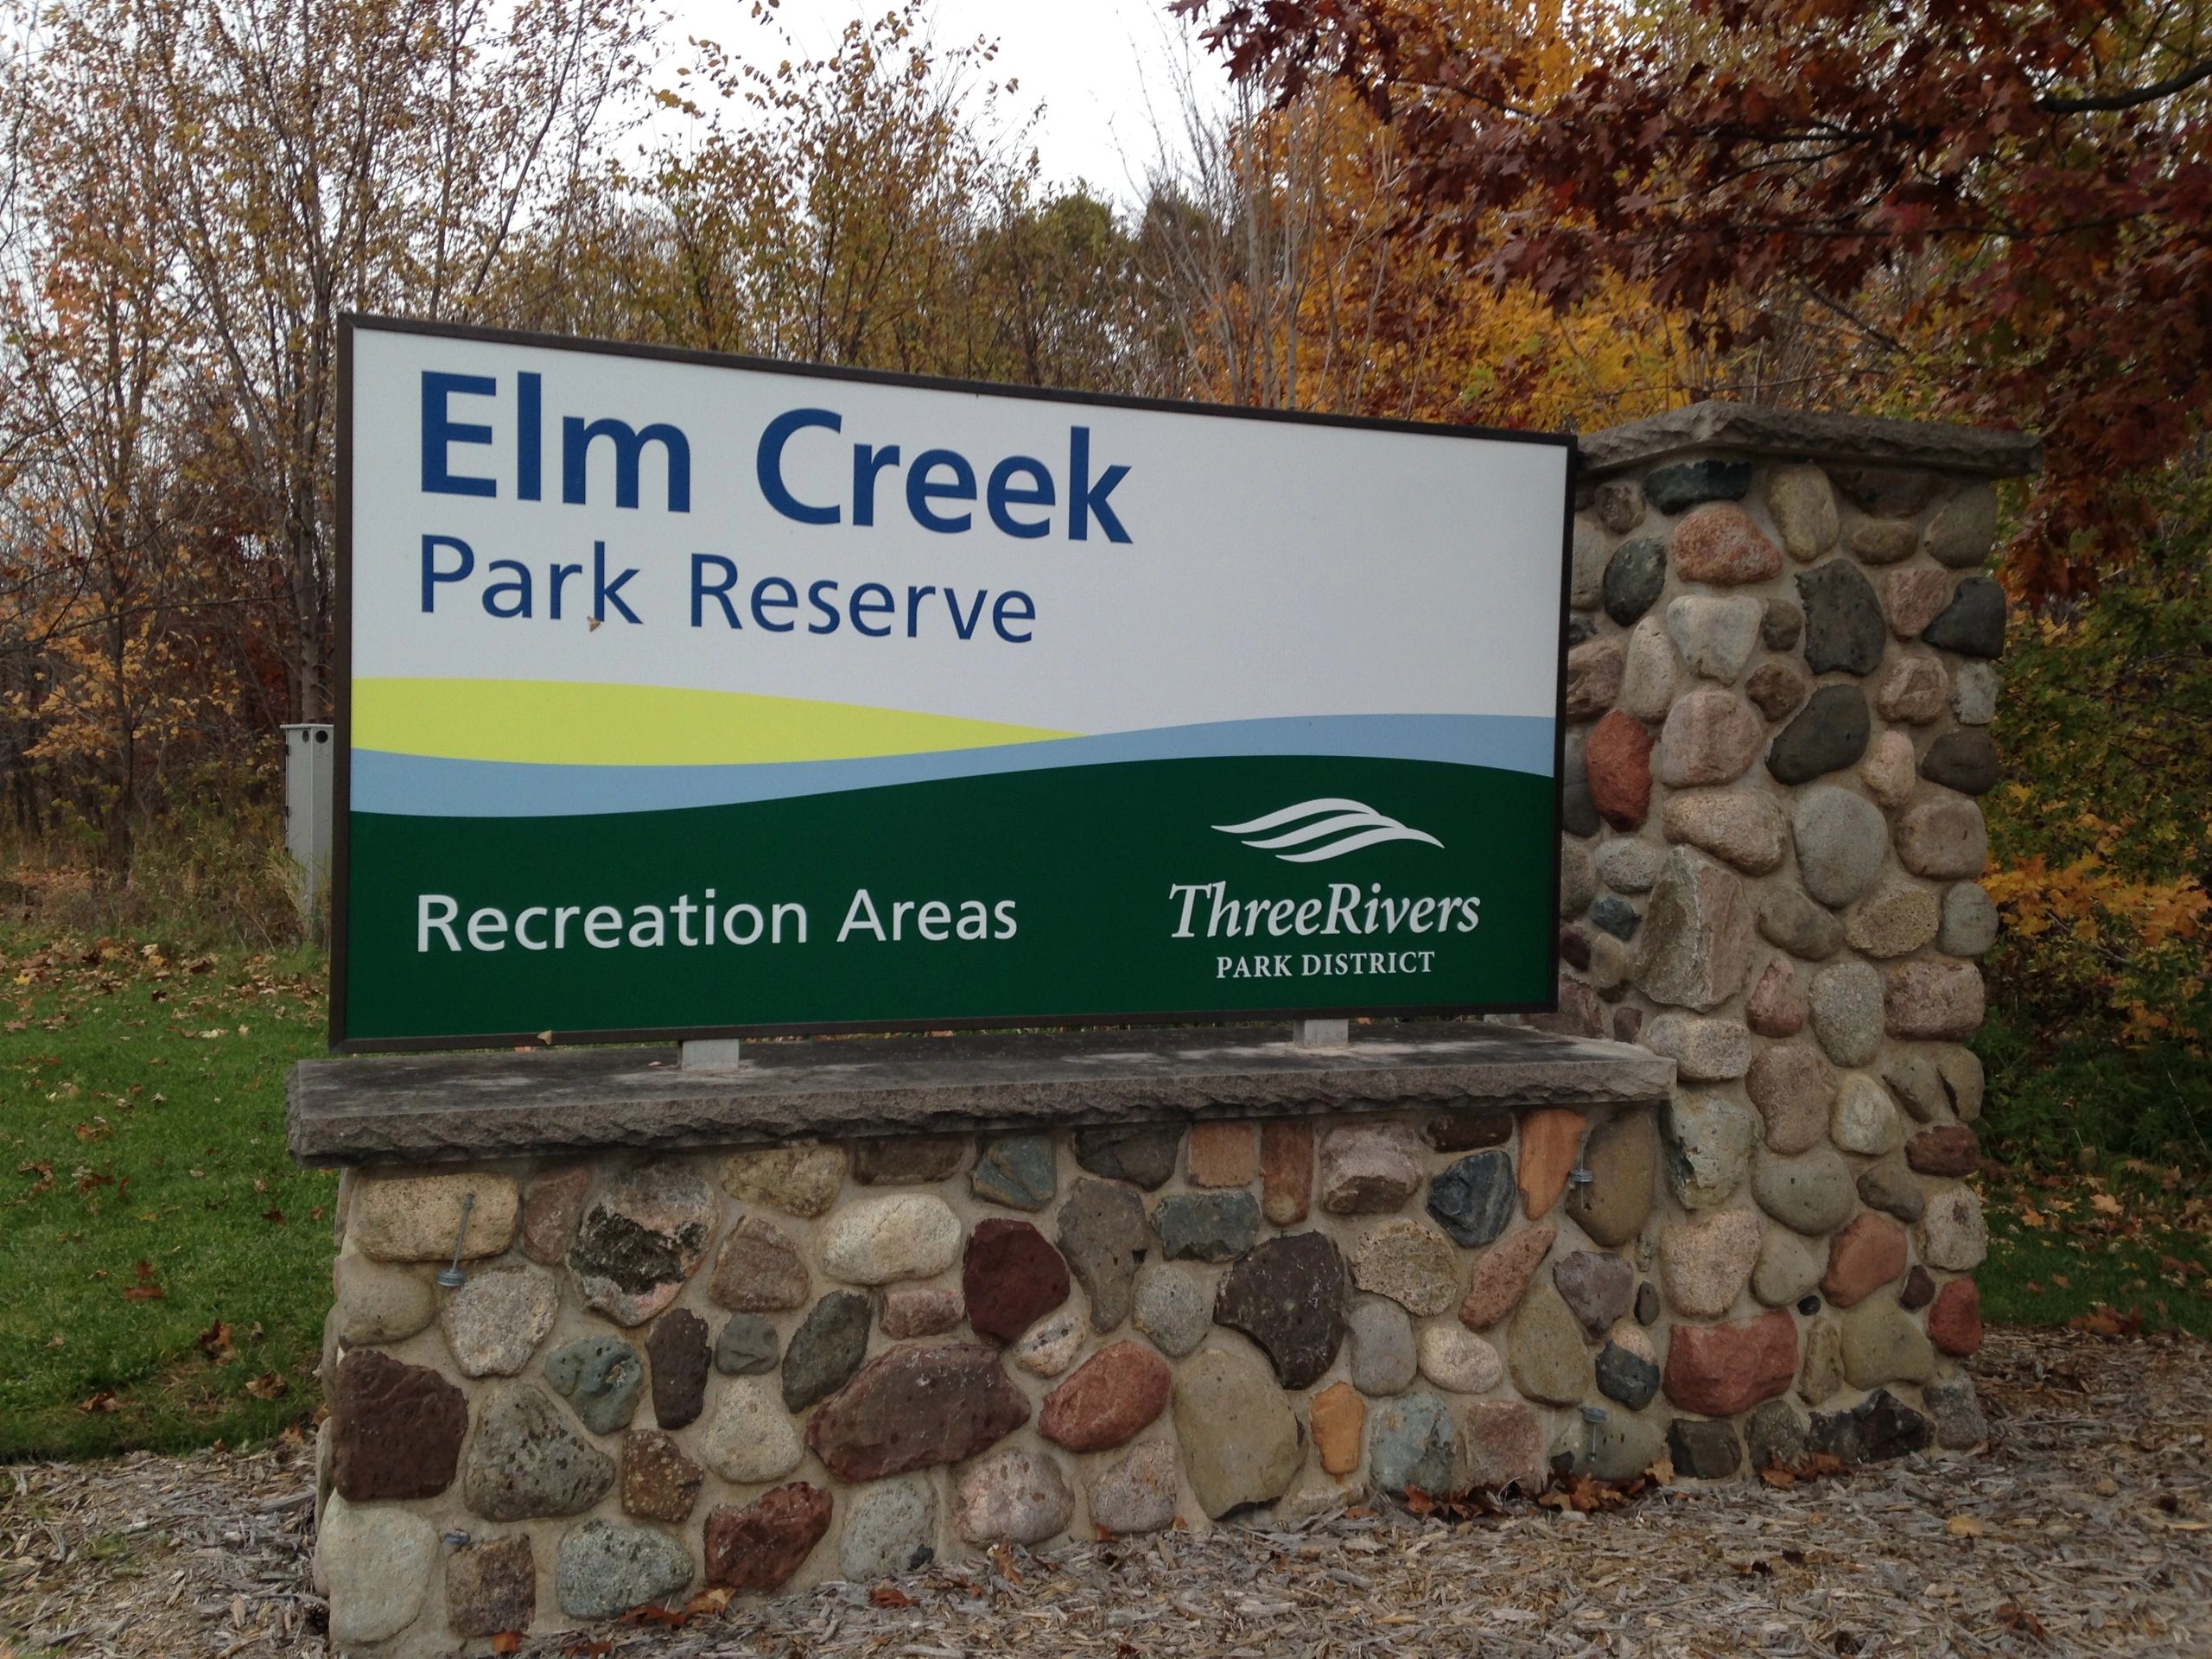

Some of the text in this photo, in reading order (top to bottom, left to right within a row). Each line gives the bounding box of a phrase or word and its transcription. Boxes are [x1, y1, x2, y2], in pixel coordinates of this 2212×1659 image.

[421, 370, 1134, 544] Elm Creek
[421, 533, 1036, 644] Park Reserve
[417, 888, 1017, 952] Recreation Areas
[1216, 951, 1435, 979] PARK DISTRICT
